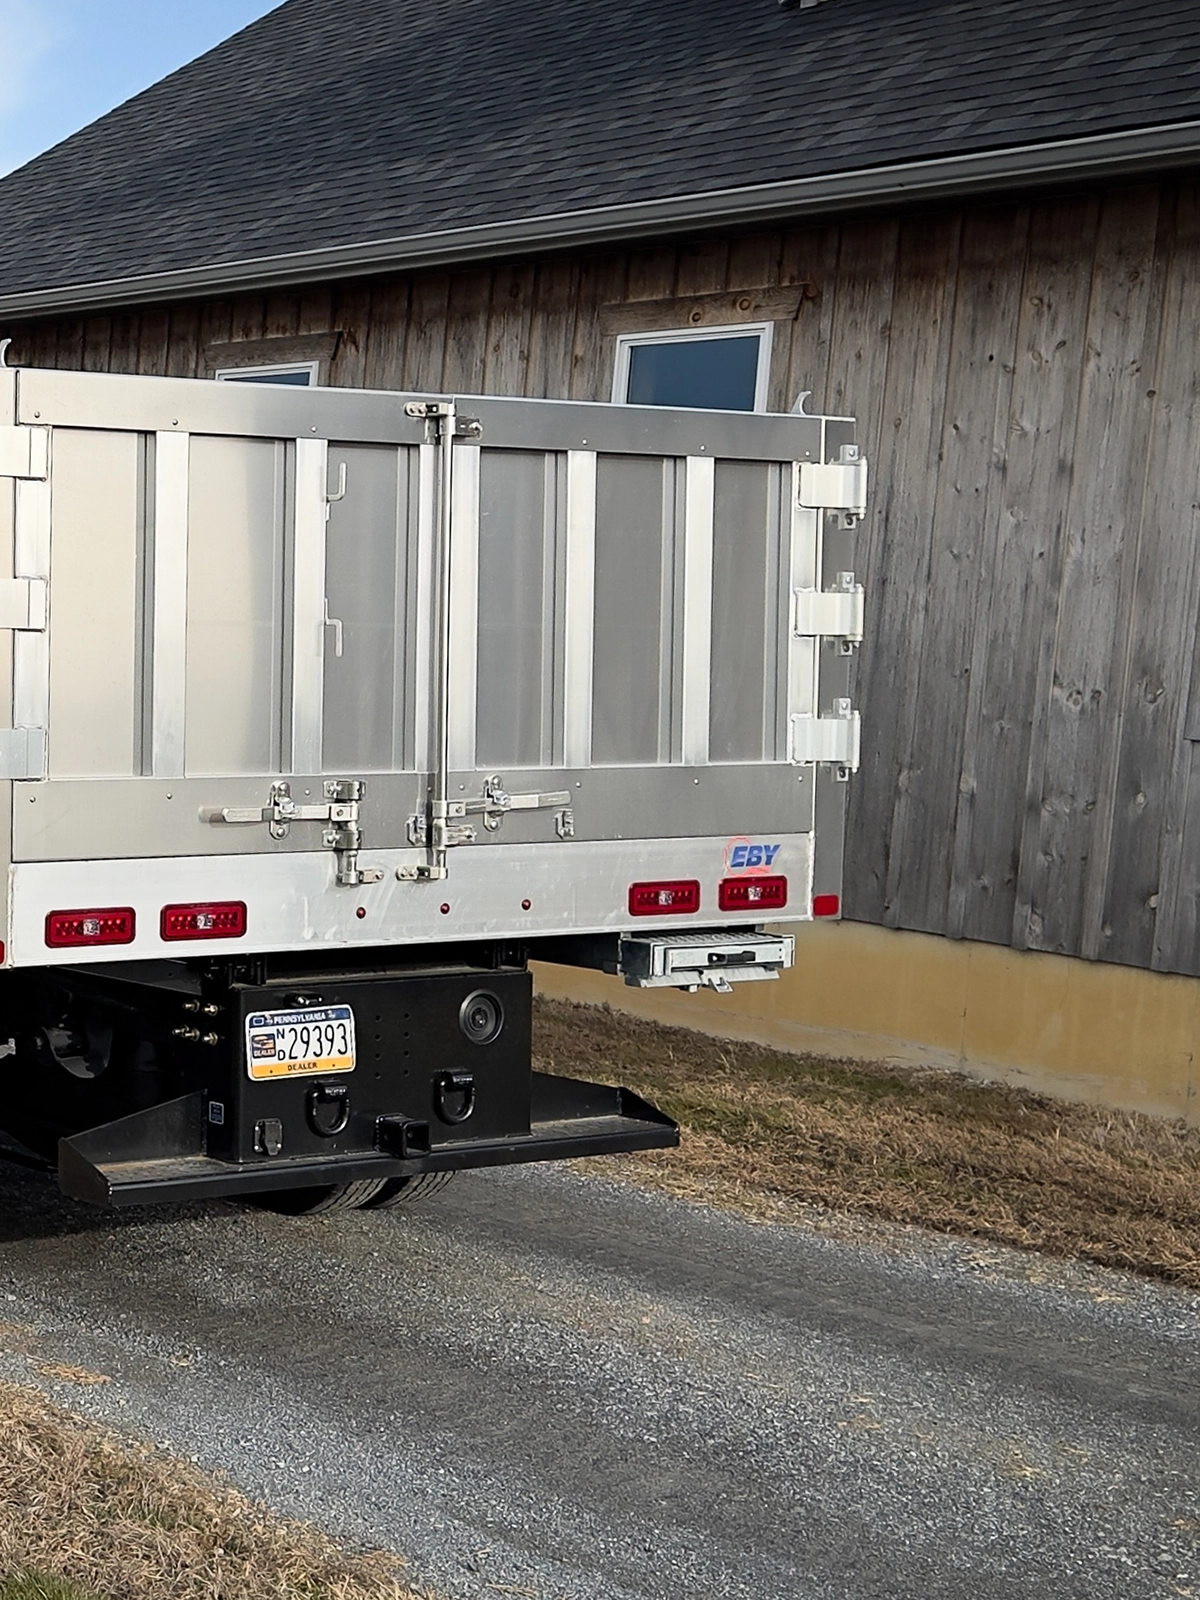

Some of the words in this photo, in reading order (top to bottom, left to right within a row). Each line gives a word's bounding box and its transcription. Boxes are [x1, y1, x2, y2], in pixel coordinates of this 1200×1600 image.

[731, 843, 781, 867] EBY
[274, 1012, 326, 1024] PENNSYLVANIA
[288, 1022, 348, 1060] 29393
[287, 1062, 318, 1071] DEALER
